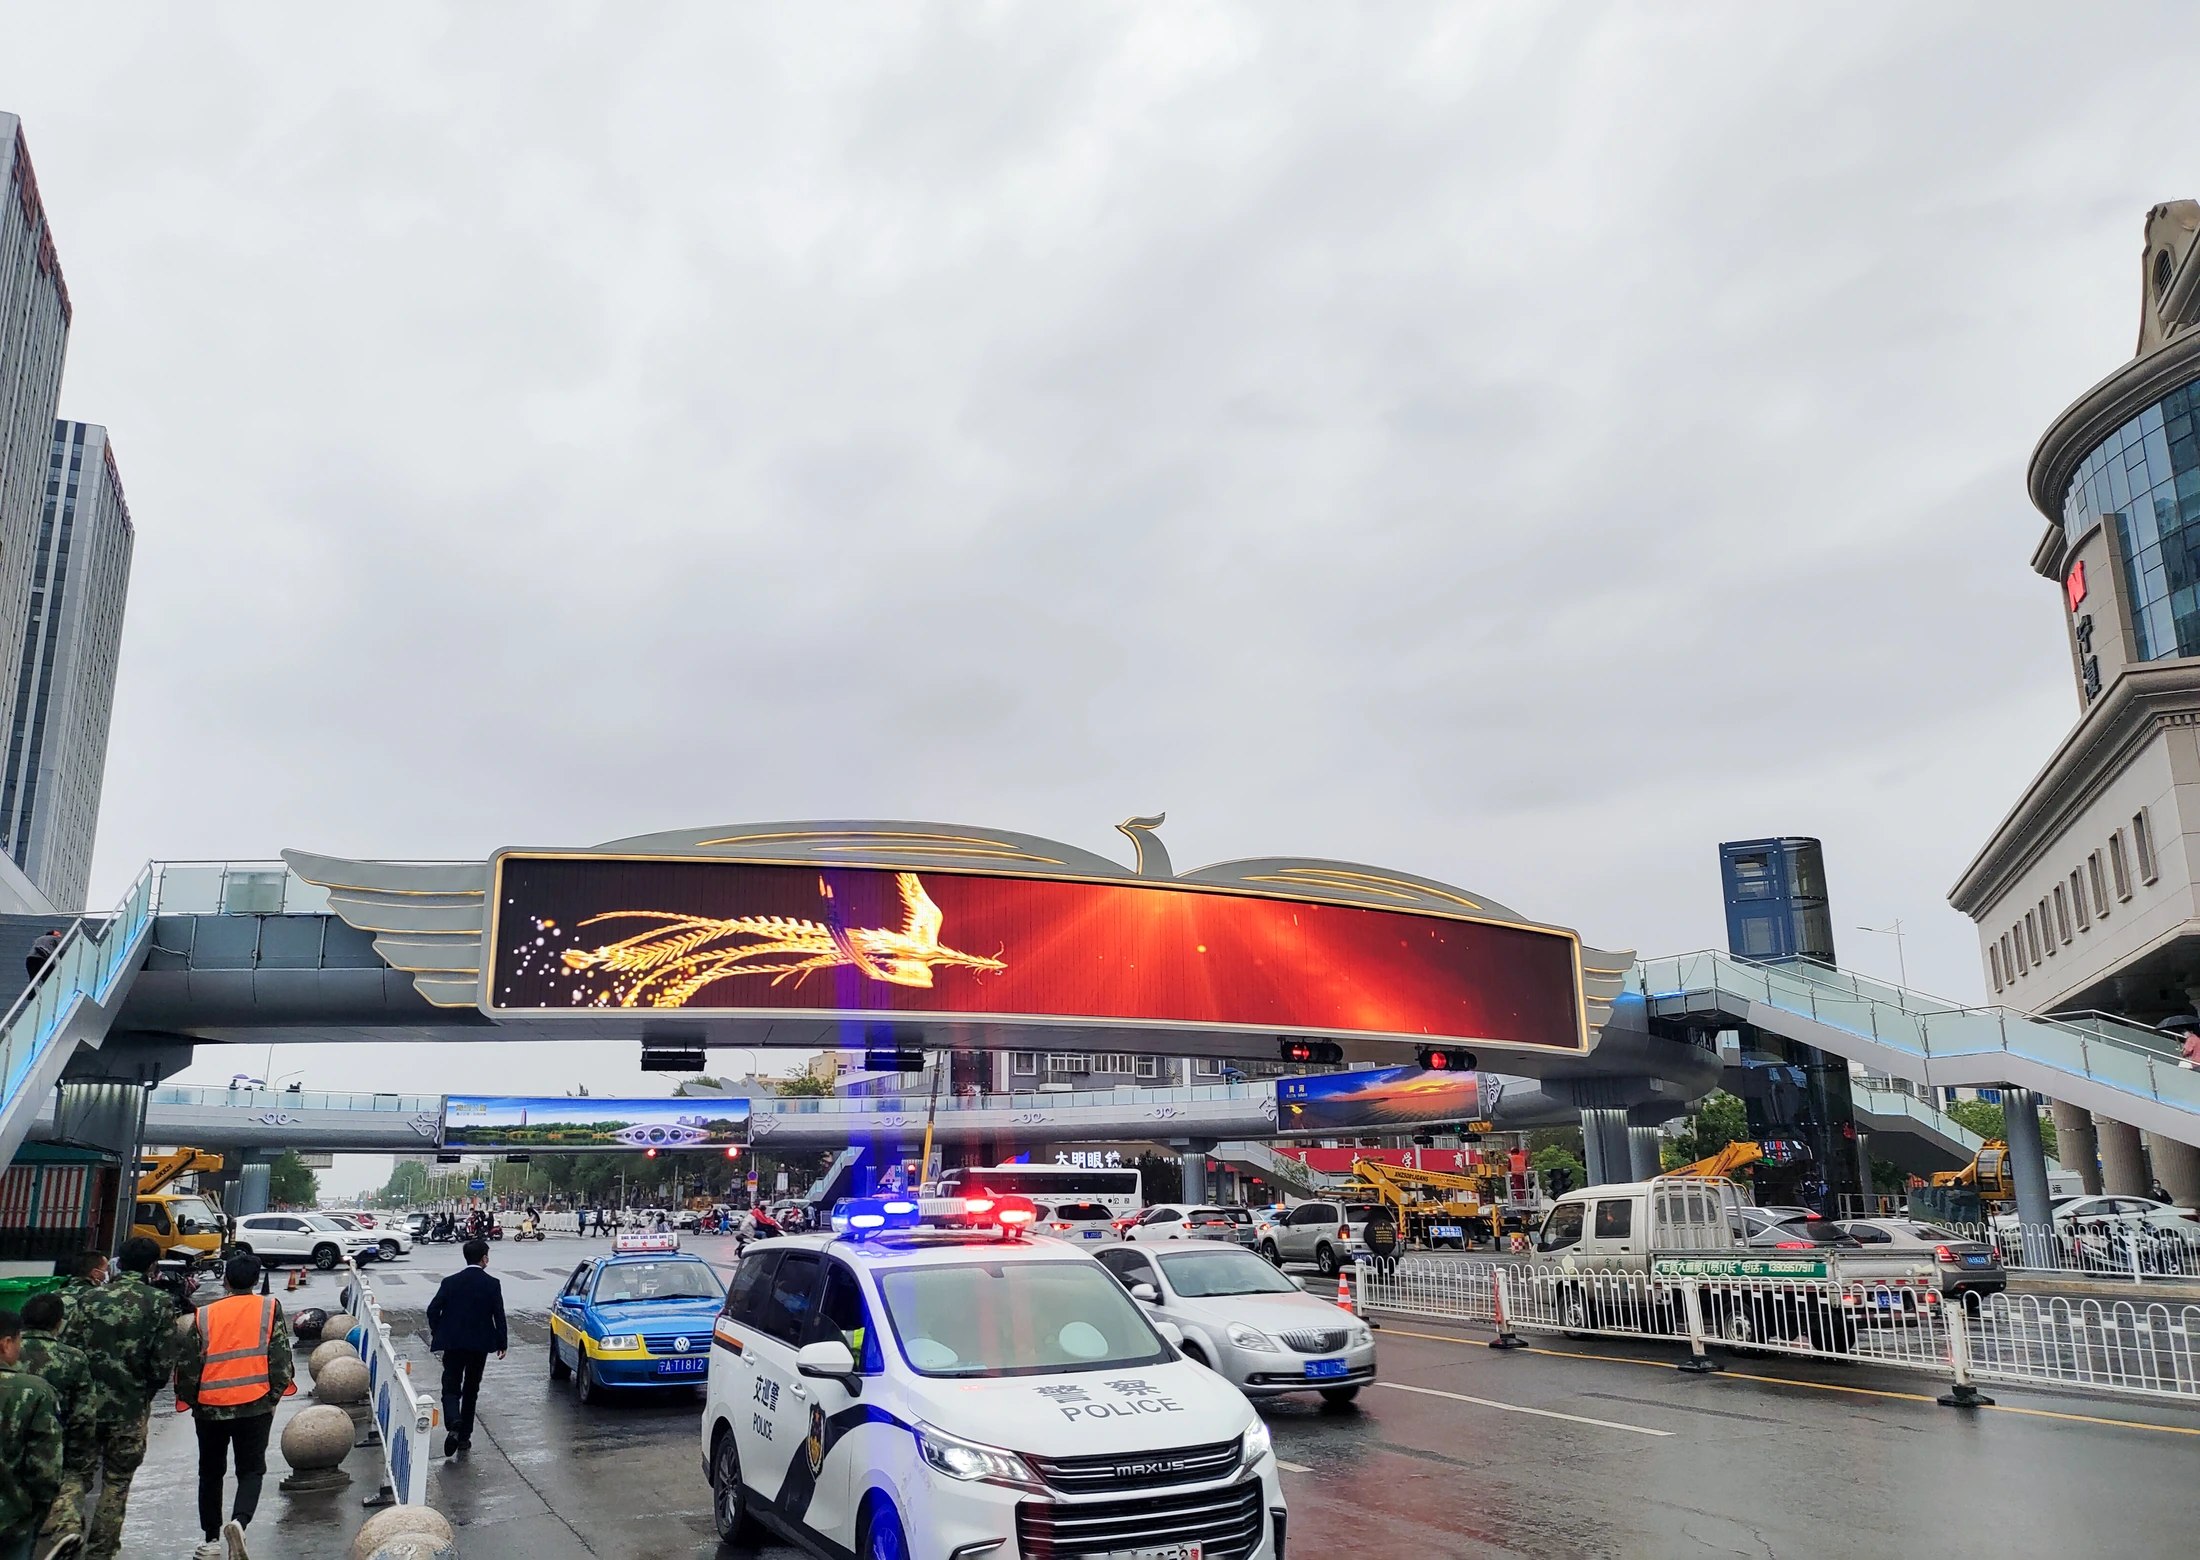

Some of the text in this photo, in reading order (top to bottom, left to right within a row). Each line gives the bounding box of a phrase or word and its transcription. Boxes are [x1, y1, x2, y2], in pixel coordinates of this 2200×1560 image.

[1055, 1150, 1122, 1168] 大明眼镜
[1032, 1379, 1162, 1404] 警察
[1060, 1397, 1185, 1422] POLICE
[752, 1411, 773, 1441] POLICE
[1116, 1461, 1185, 1477] MAXUS
